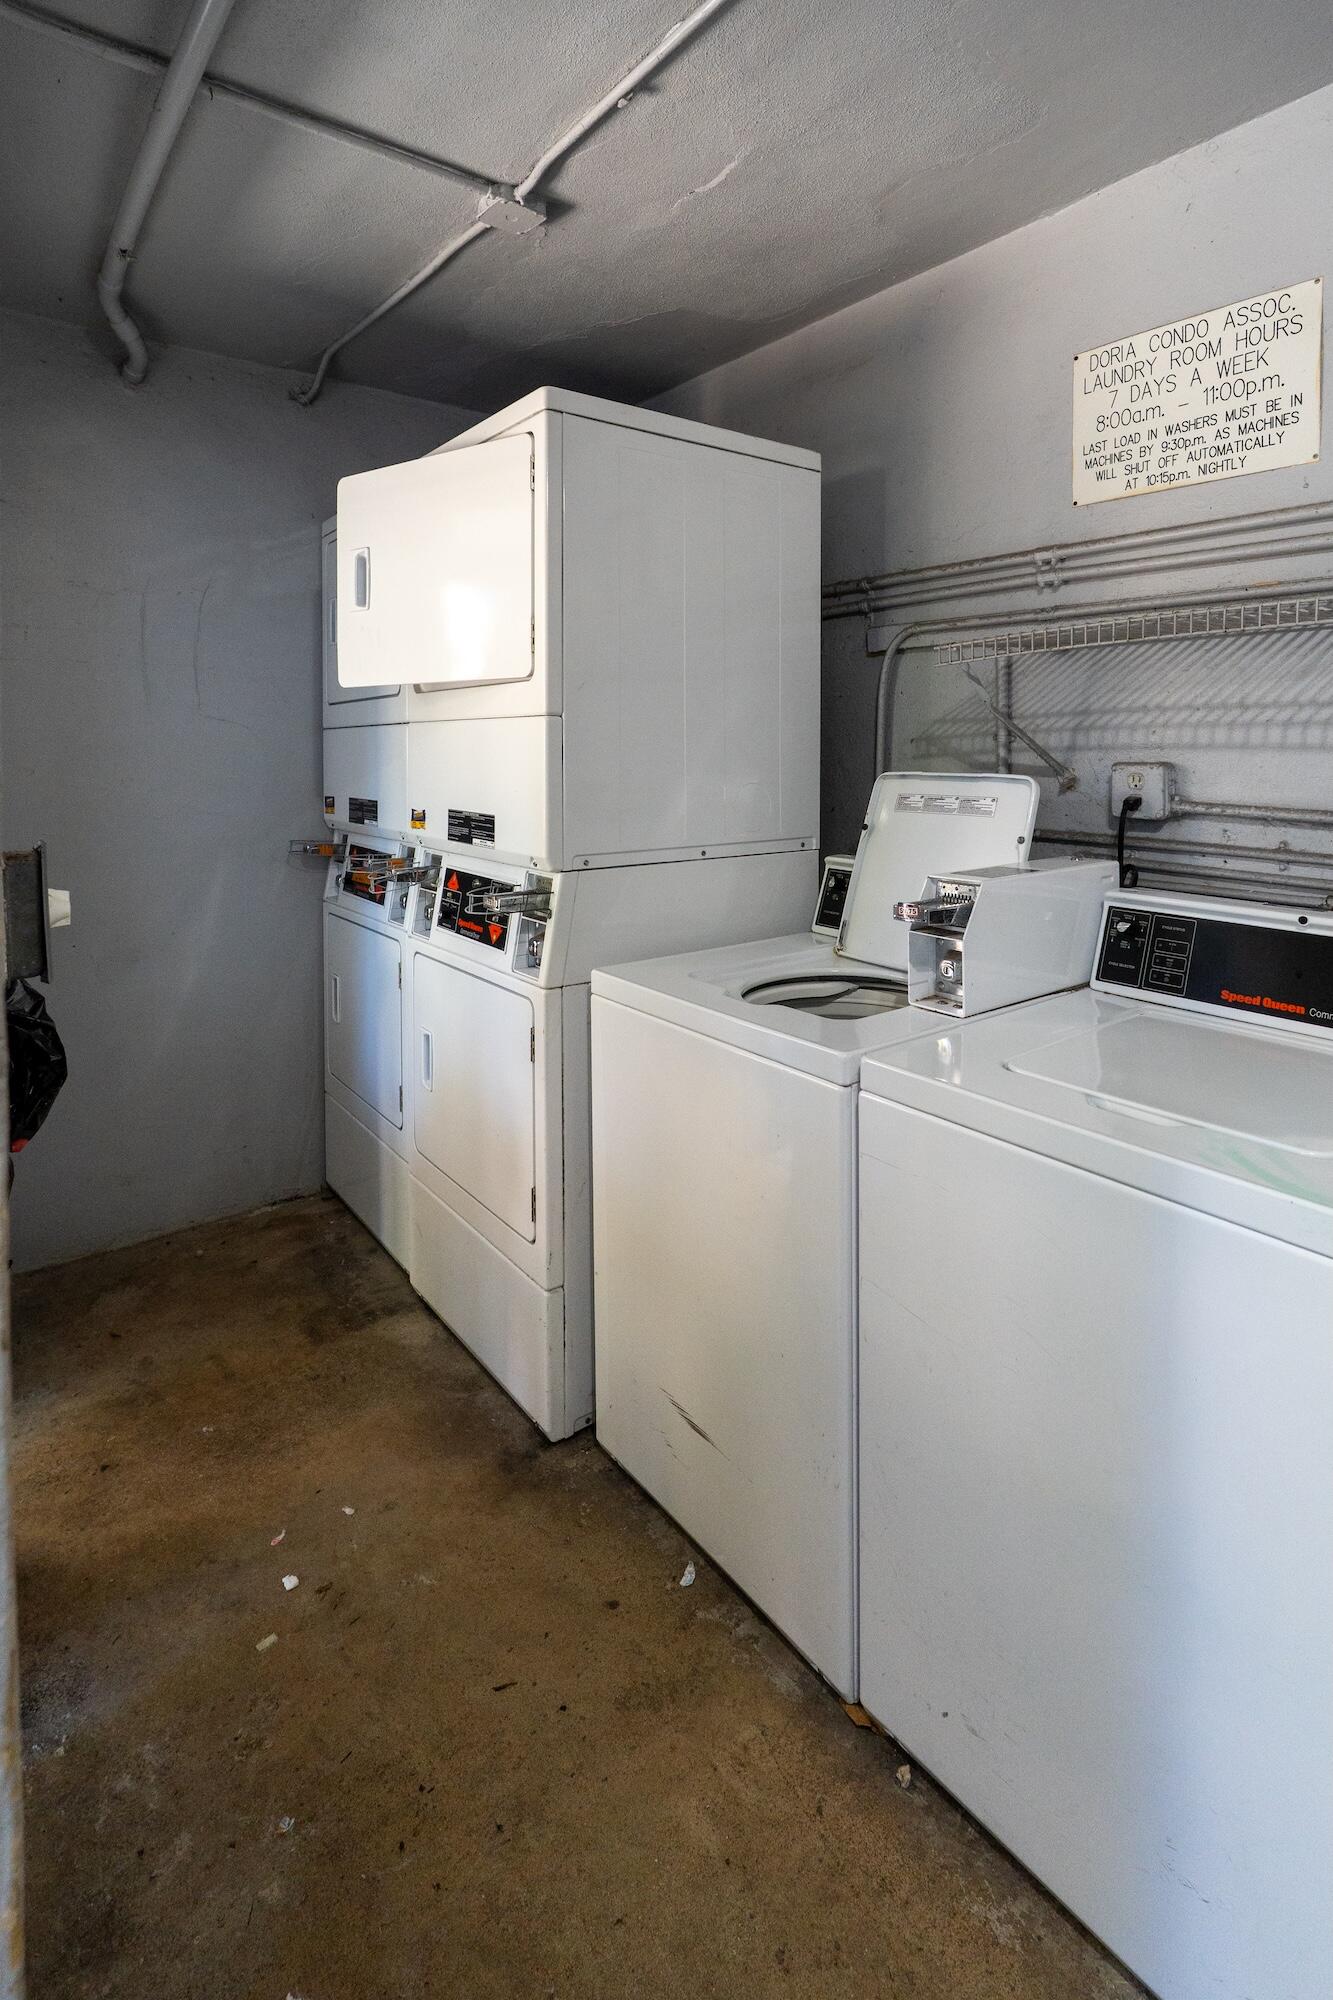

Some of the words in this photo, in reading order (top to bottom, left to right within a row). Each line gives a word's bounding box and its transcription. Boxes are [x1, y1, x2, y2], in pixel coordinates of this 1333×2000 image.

[1083, 356, 1158, 395] LAUNDRY
[1170, 337, 1222, 370] ROOM
[1235, 313, 1304, 352] HOURS
[1089, 341, 1137, 373] DORIA
[1148, 318, 1209, 353] CONDO
[1223, 293, 1296, 332] ASSOC.
[1096, 405, 1165, 433] 8:00a.m.
[1203, 373, 1285, 406] 11:00p.m.
[1108, 389, 1119, 409] 7
[1130, 373, 1177, 403] DAYS
[1190, 367, 1203, 388] A
[1216, 347, 1270, 379] WEEK
[1082, 439, 1108, 457] LAST
[1114, 432, 1141, 449] LOAD
[1147, 427, 1158, 441] IN
[1164, 413, 1218, 437] WASHERS
[1225, 402, 1258, 423] MUST
[1265, 397, 1282, 413] BE
[1290, 392, 1304, 408] IN
[1084, 449, 1133, 470] MACHINES
[1139, 444, 1154, 458] BY
[1161, 436, 1207, 454] 9:30p.m.
[1214, 426, 1231, 441] AS
[1238, 410, 1300, 436] MACHINES
[1095, 467, 1118, 482] WILL
[1124, 459, 1151, 476] SHUT
[1157, 453, 1179, 469] OFF
[1186, 430, 1286, 463] AUTOMATICALLY
[1124, 476, 1139, 491] AT
[1145, 469, 1191, 486] 10:15p.m.
[1197, 455, 1248, 477] NIGHTLY
[1220, 989, 1261, 1006] Speed
[1262, 997, 1306, 1015] Queen
